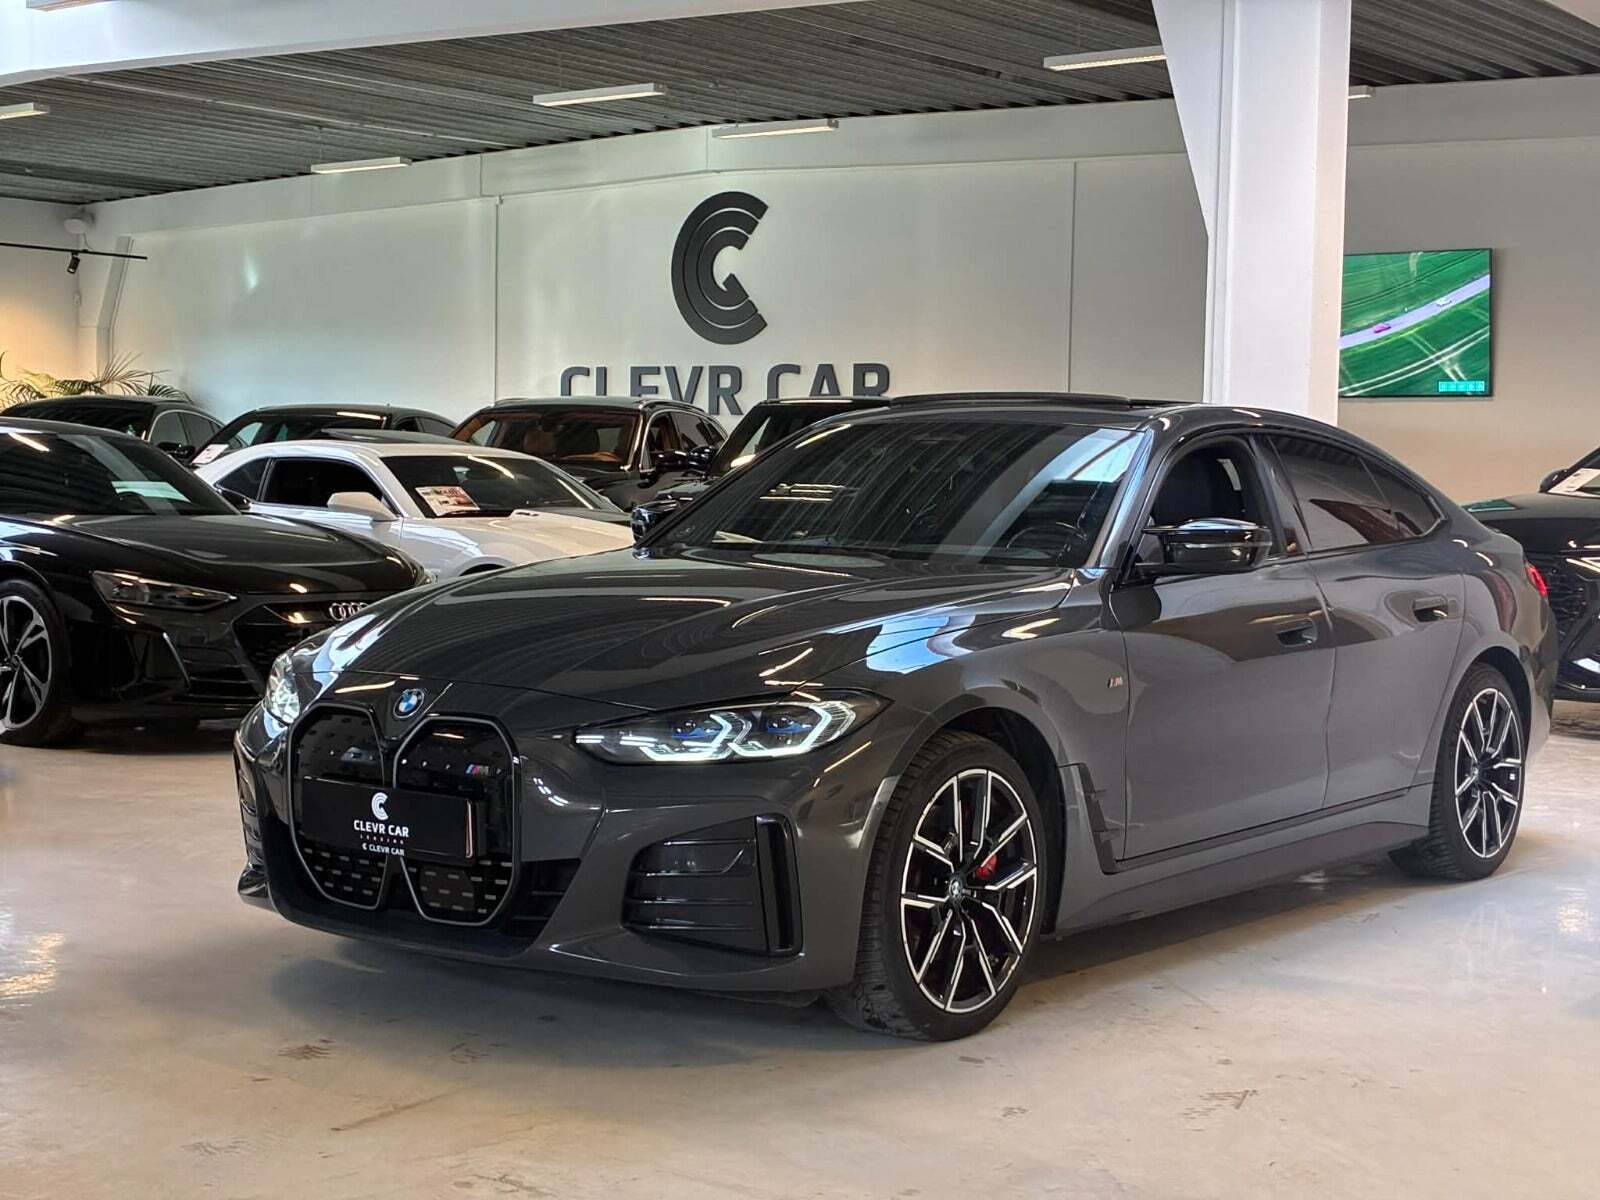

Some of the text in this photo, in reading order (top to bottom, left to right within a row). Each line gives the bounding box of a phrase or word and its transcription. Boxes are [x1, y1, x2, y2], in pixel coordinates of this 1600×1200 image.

[560, 363, 890, 416] CLEVR CAR
[353, 820, 410, 837] CLEVR CAR
[368, 843, 390, 854] CLEVR
